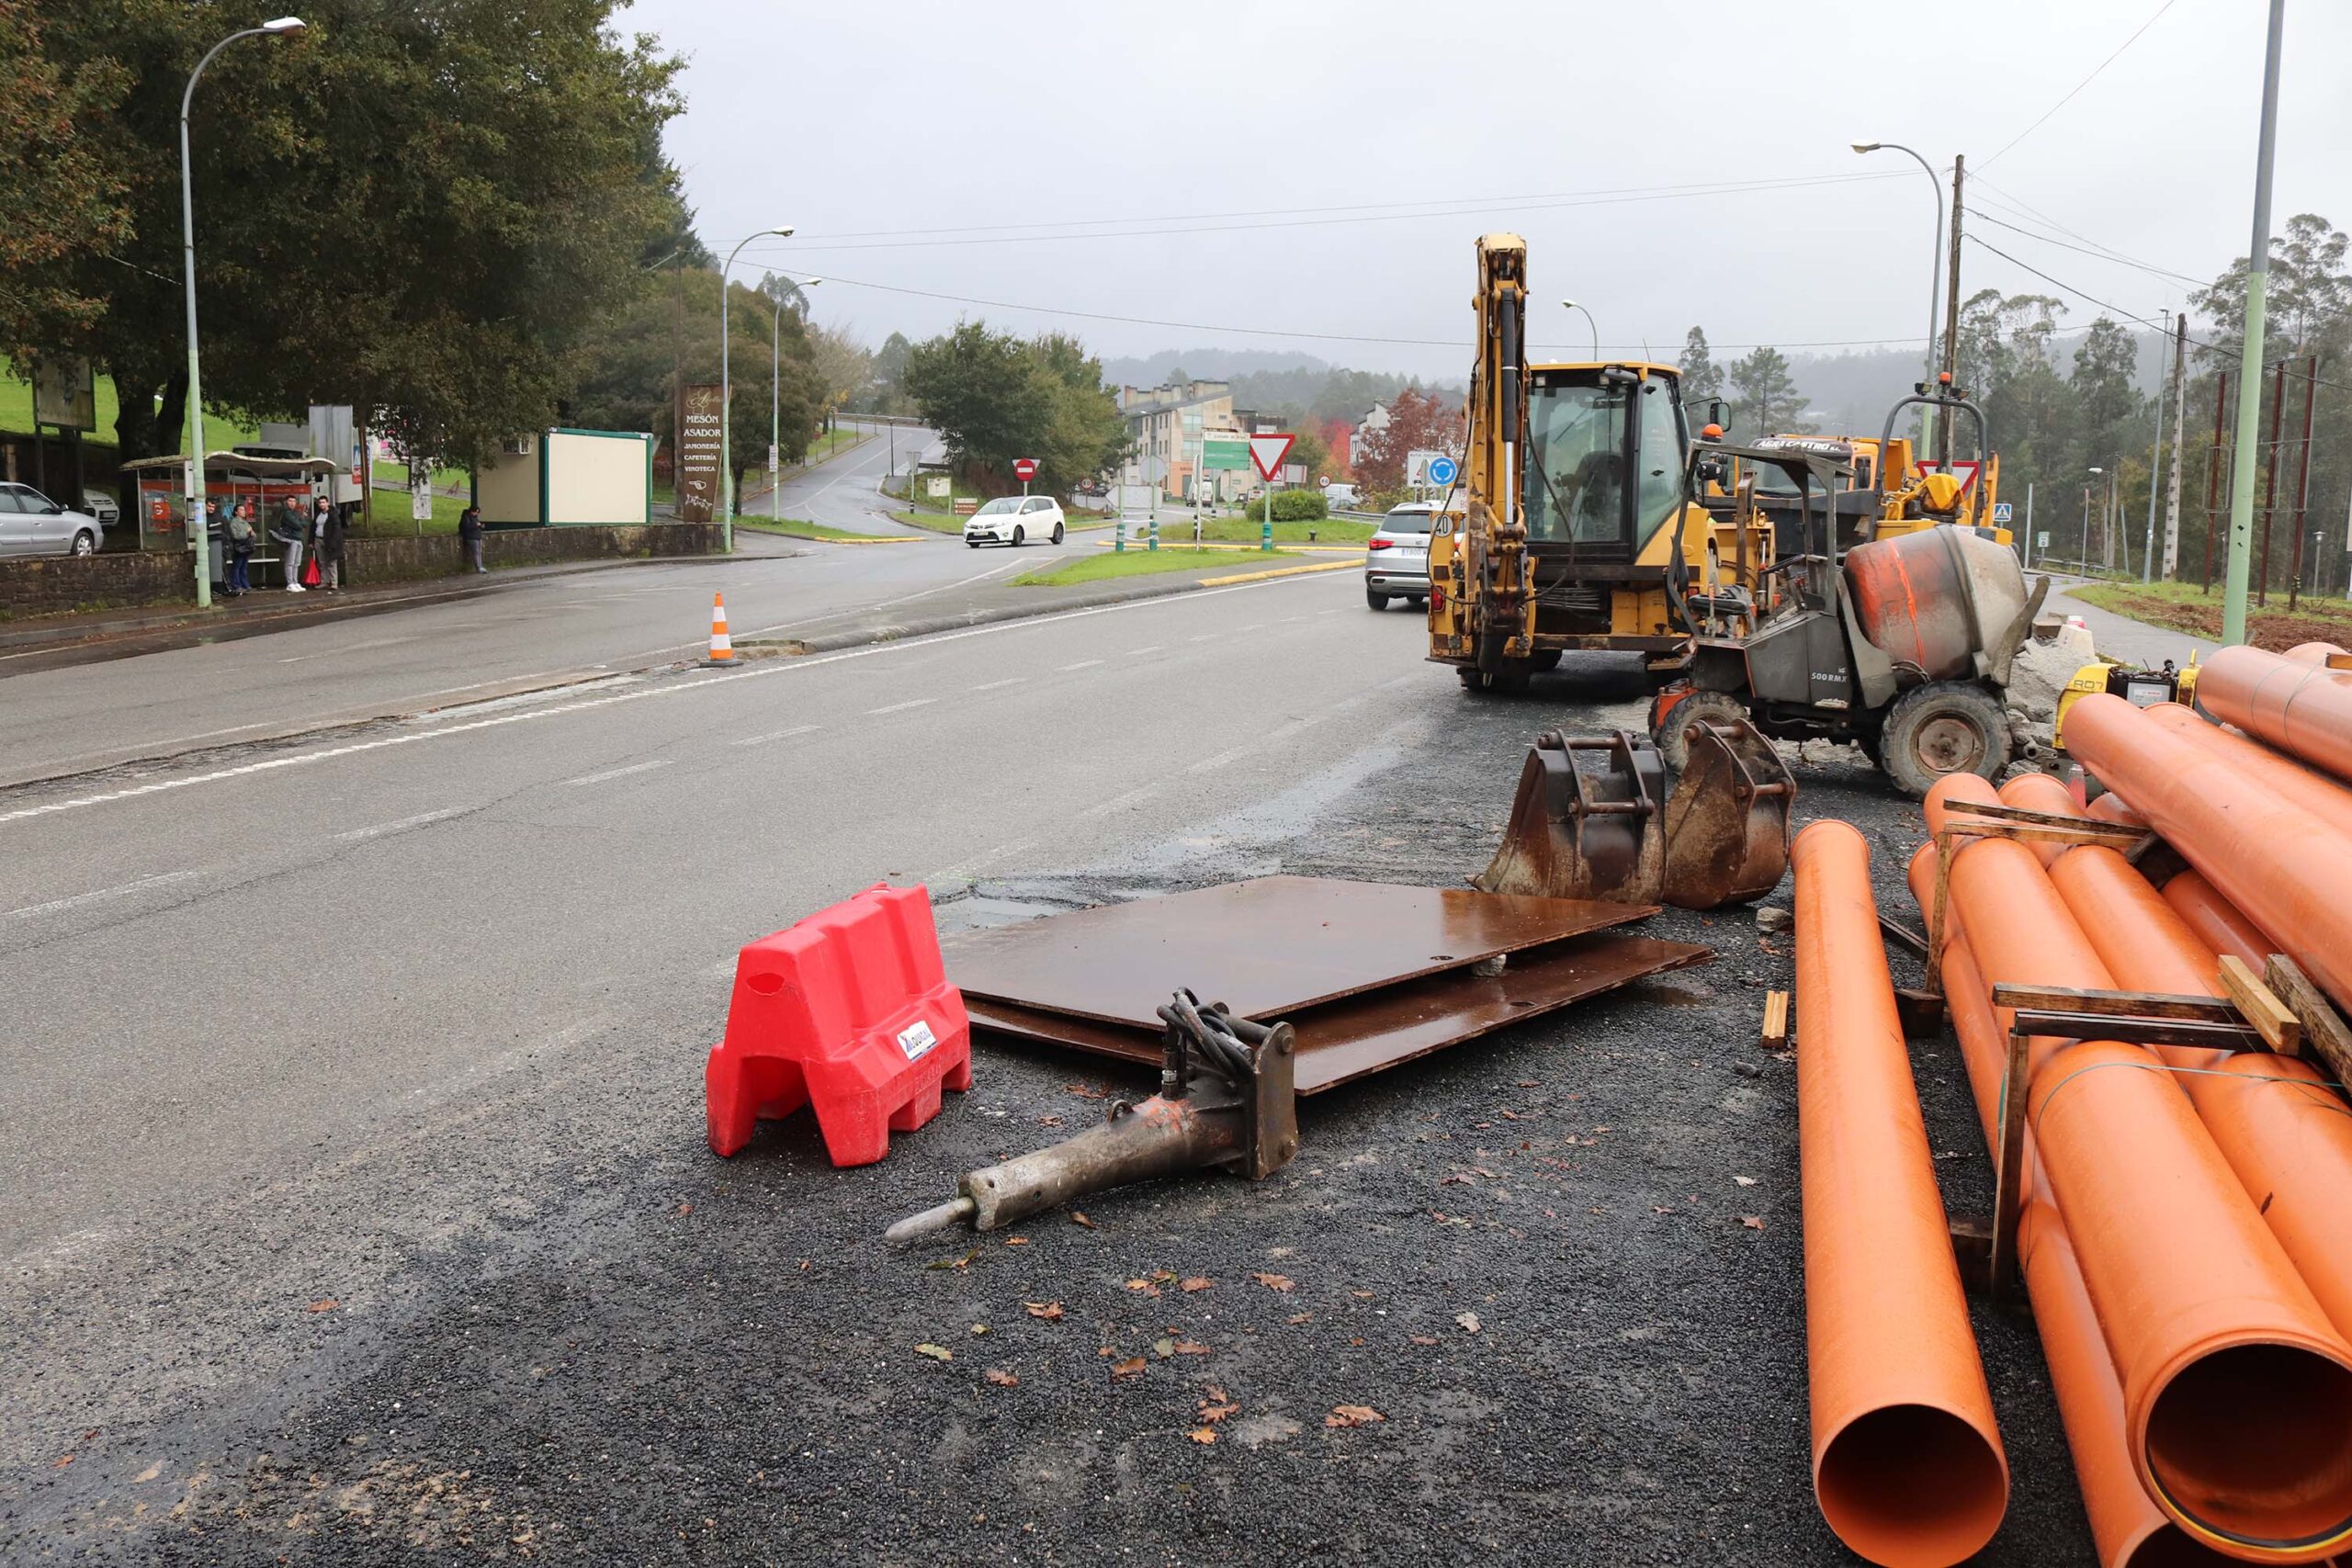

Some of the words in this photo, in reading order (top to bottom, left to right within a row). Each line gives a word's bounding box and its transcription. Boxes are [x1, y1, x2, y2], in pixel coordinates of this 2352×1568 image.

[686, 413, 718, 424] MESÓN
[684, 428, 721, 437] ASADOR
[684, 441, 721, 450] JAMONERÍA
